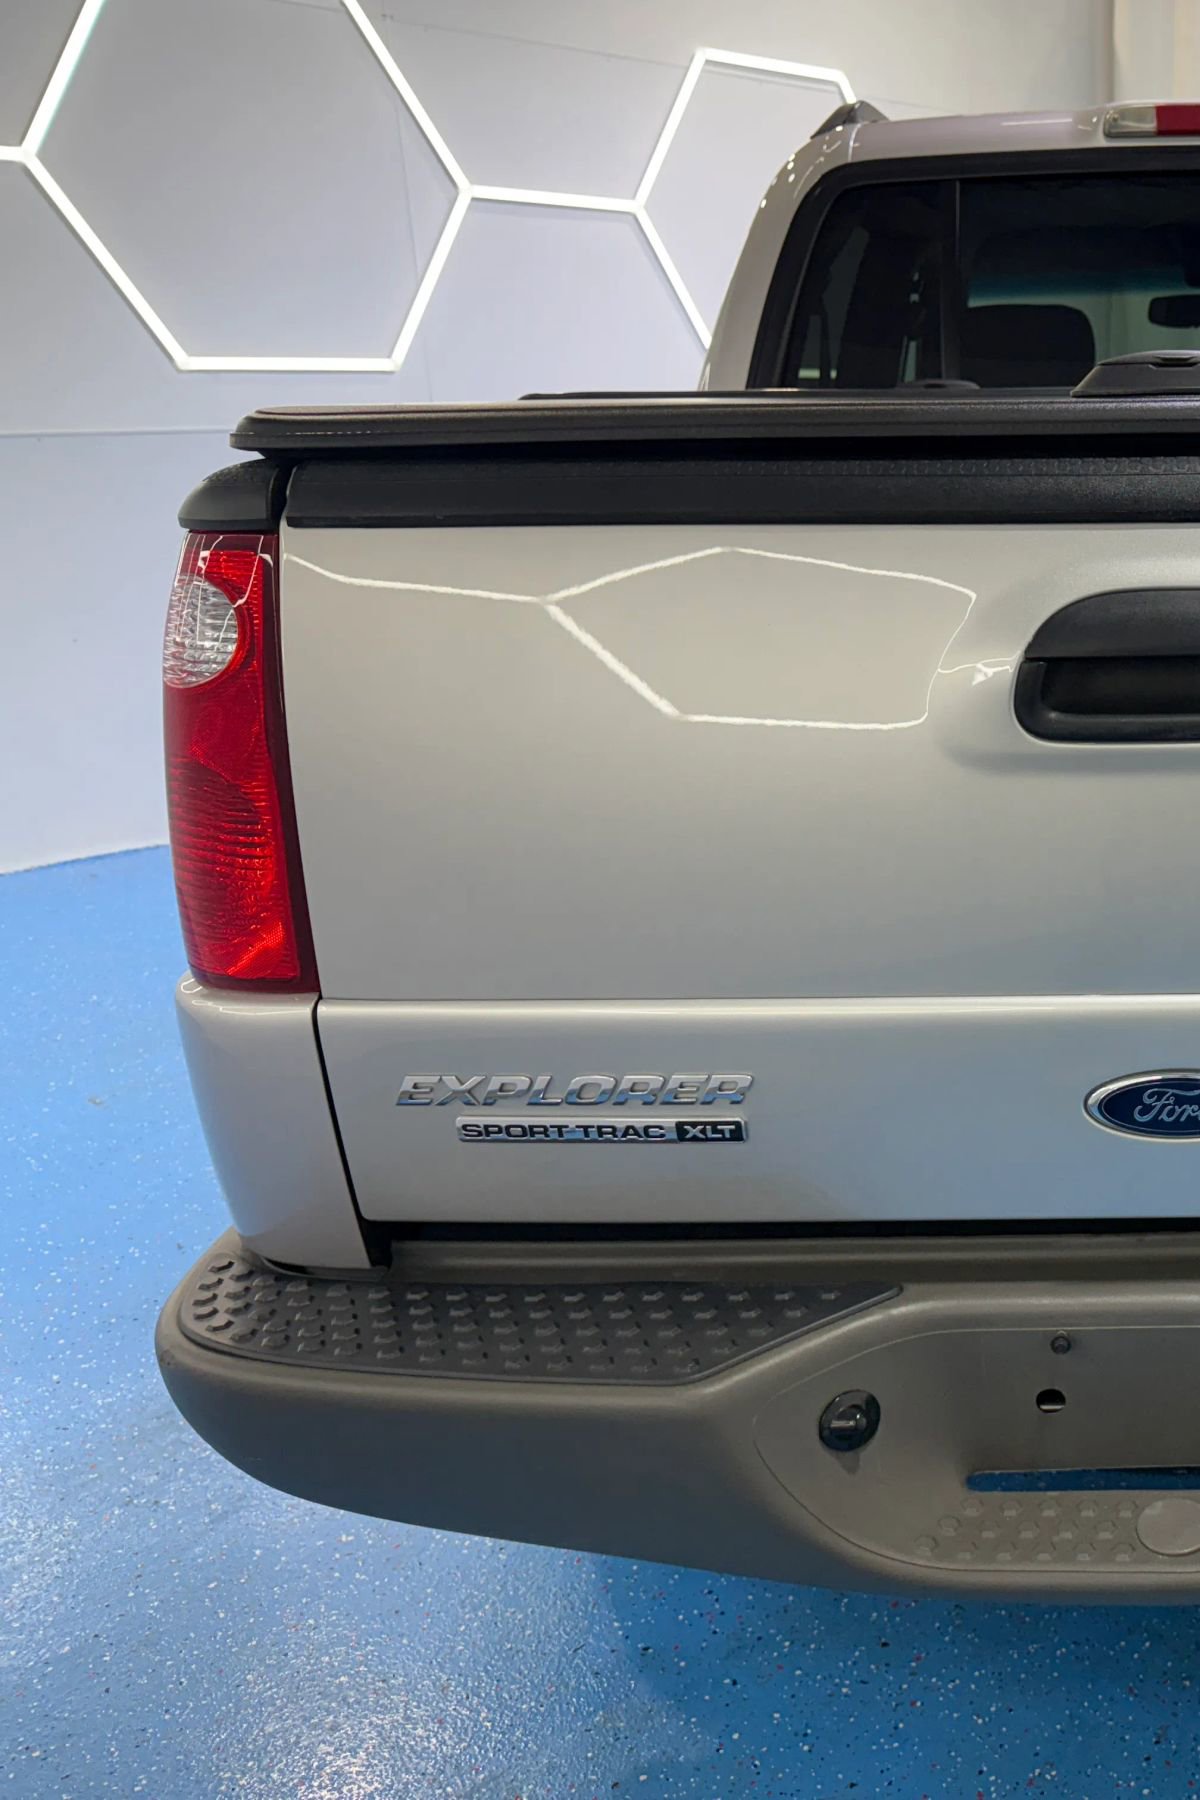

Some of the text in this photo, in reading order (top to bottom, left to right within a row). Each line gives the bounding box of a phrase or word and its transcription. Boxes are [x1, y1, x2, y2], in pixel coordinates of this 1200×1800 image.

[395, 1073, 754, 1106] EXPLORER
[461, 1123, 737, 1139] SPORT TRAC XLT
